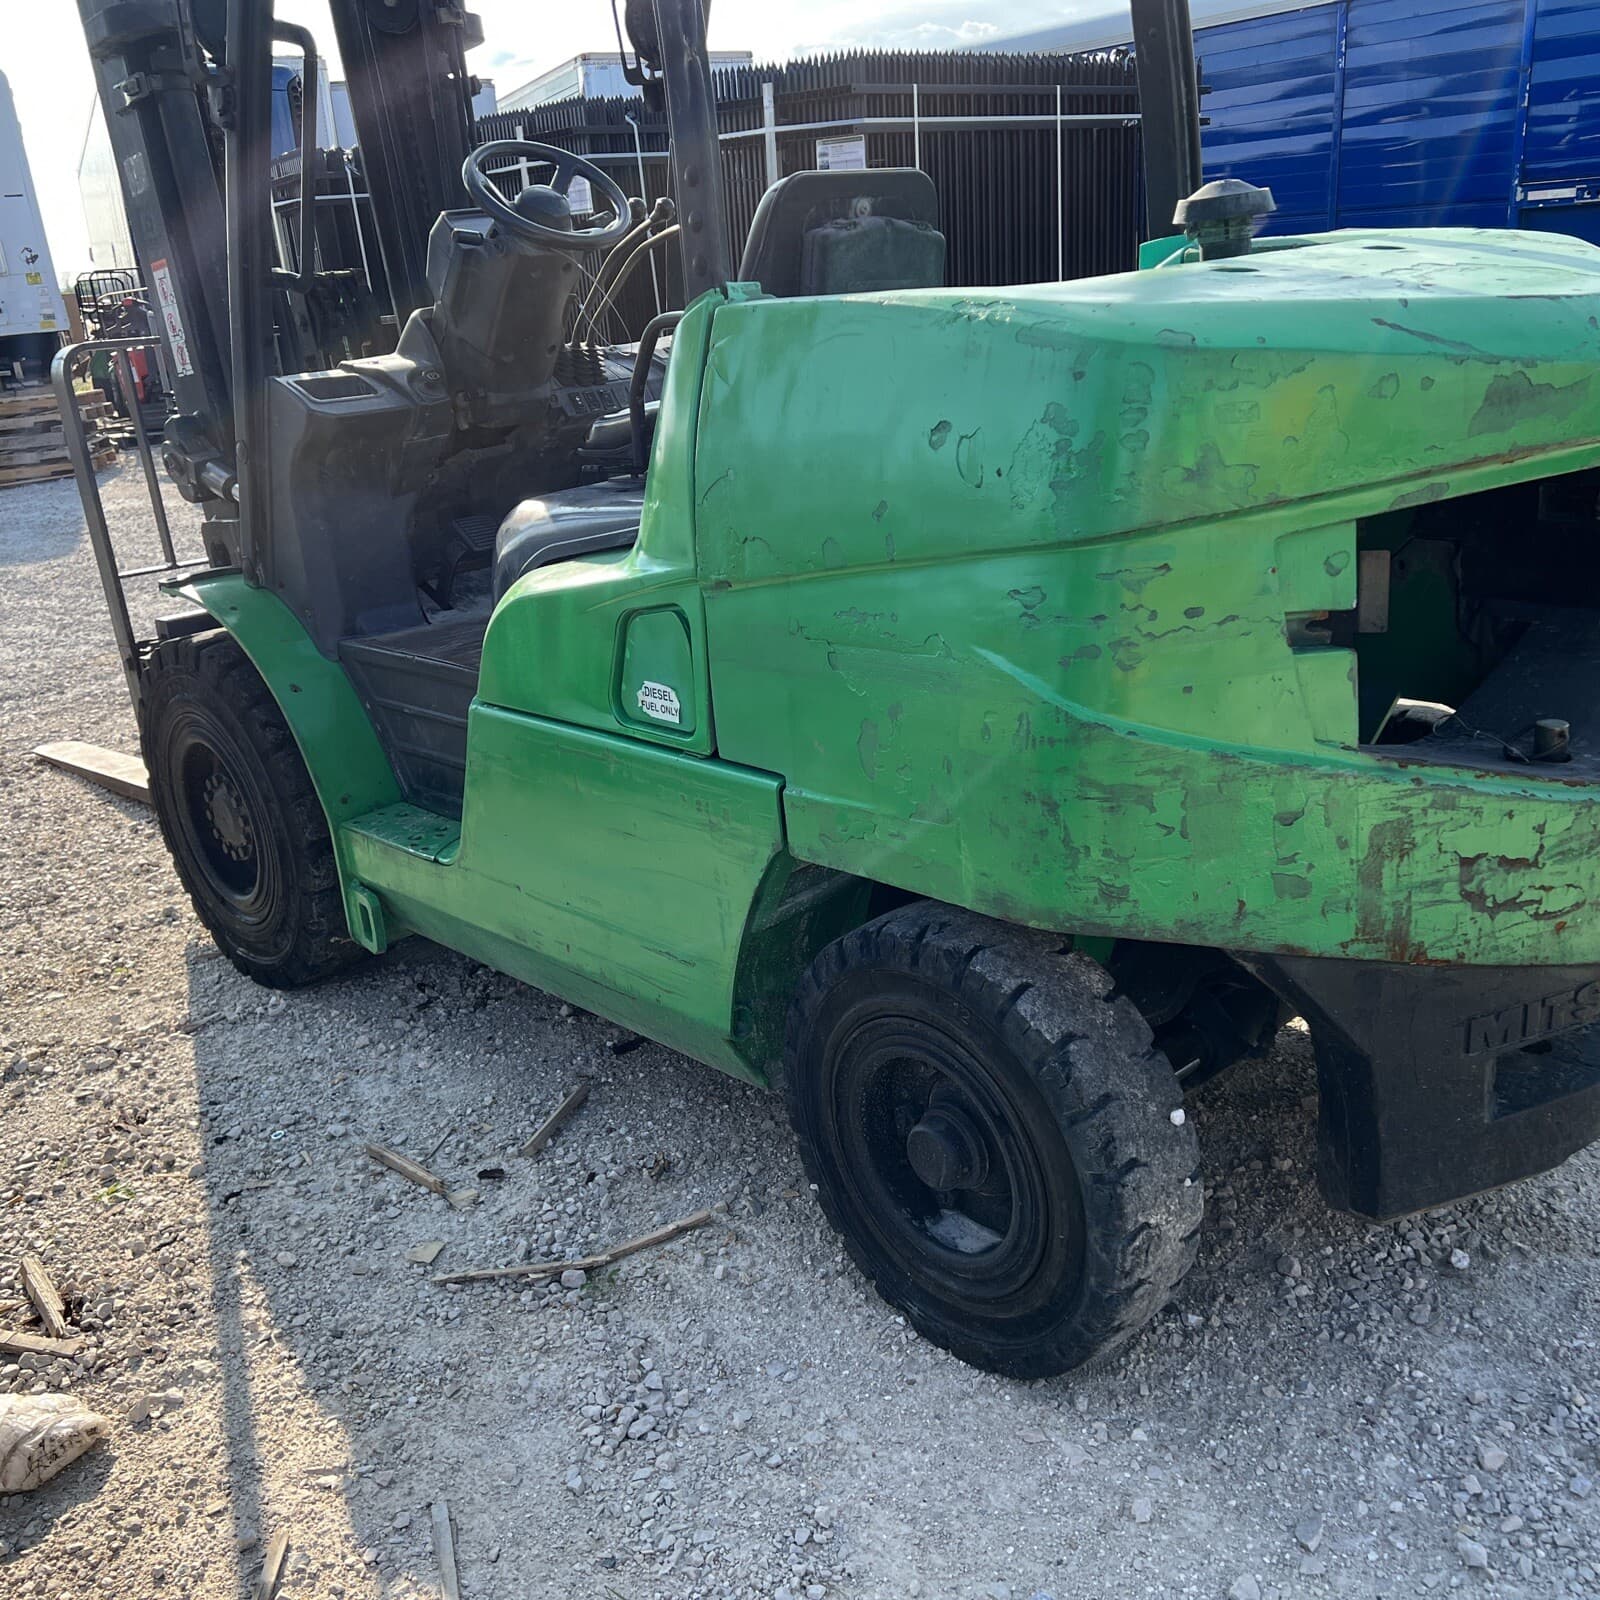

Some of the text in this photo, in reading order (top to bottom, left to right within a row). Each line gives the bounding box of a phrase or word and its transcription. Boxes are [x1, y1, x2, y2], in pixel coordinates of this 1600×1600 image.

[644, 686, 674, 703] DIESEL
[641, 700, 679, 717] FUEL ONLY
